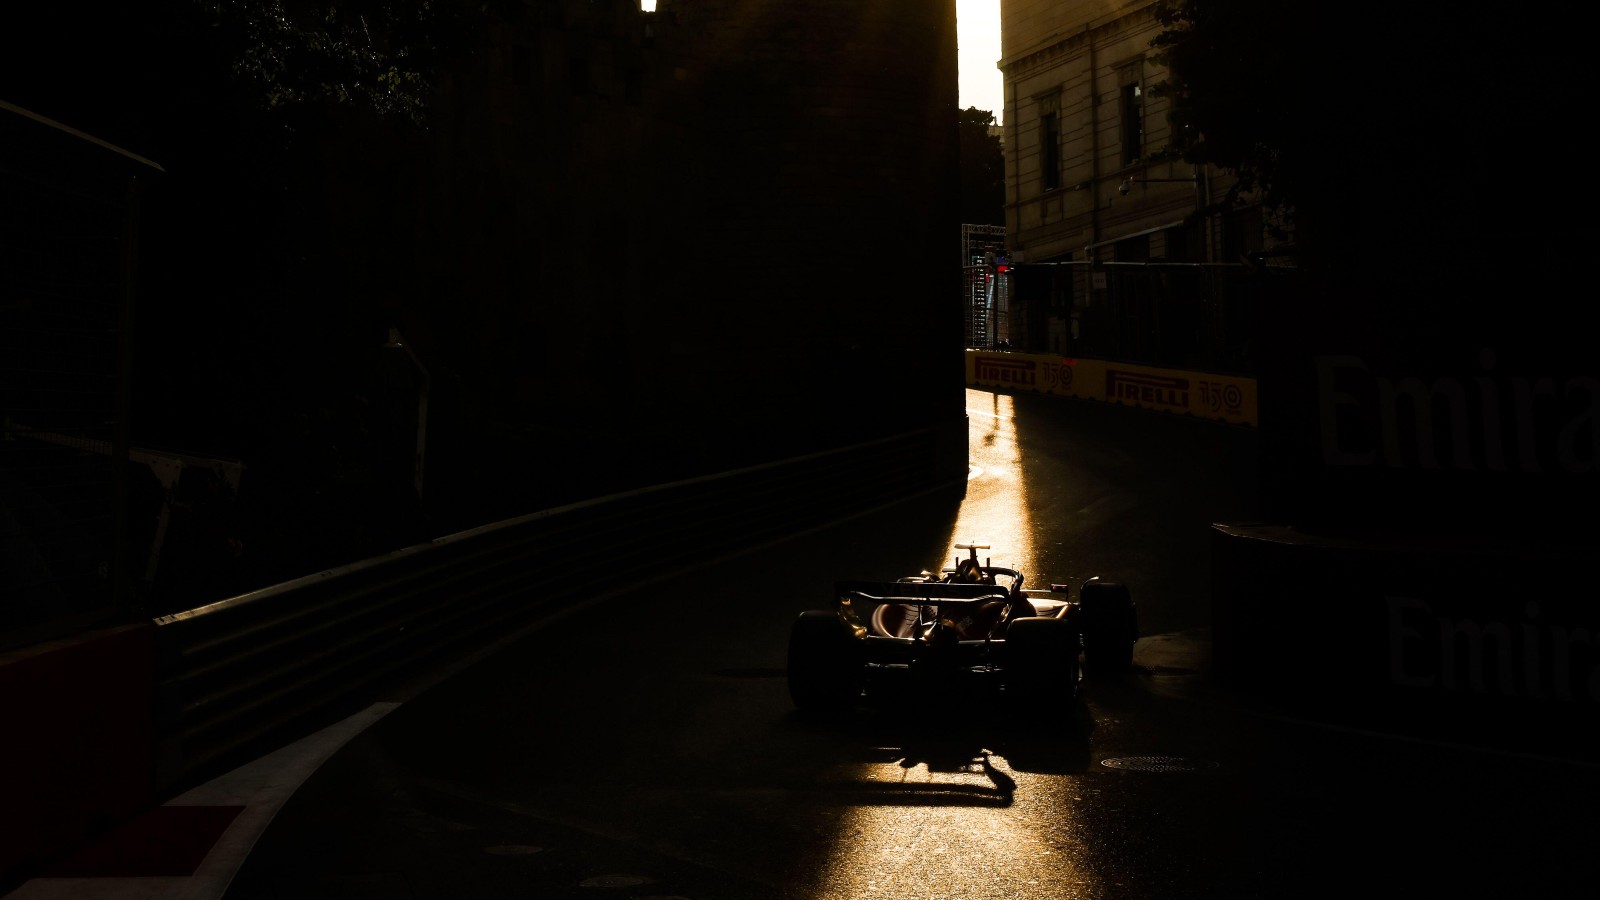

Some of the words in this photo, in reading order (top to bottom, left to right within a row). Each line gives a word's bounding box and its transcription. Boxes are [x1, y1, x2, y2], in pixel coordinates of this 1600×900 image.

[975, 356, 1035, 385] PIRELLI
[1043, 361, 1073, 388] 150
[1106, 370, 1189, 408] PIRELLI
[1199, 381, 1242, 412] 150
[1384, 594, 1600, 703] Emir
